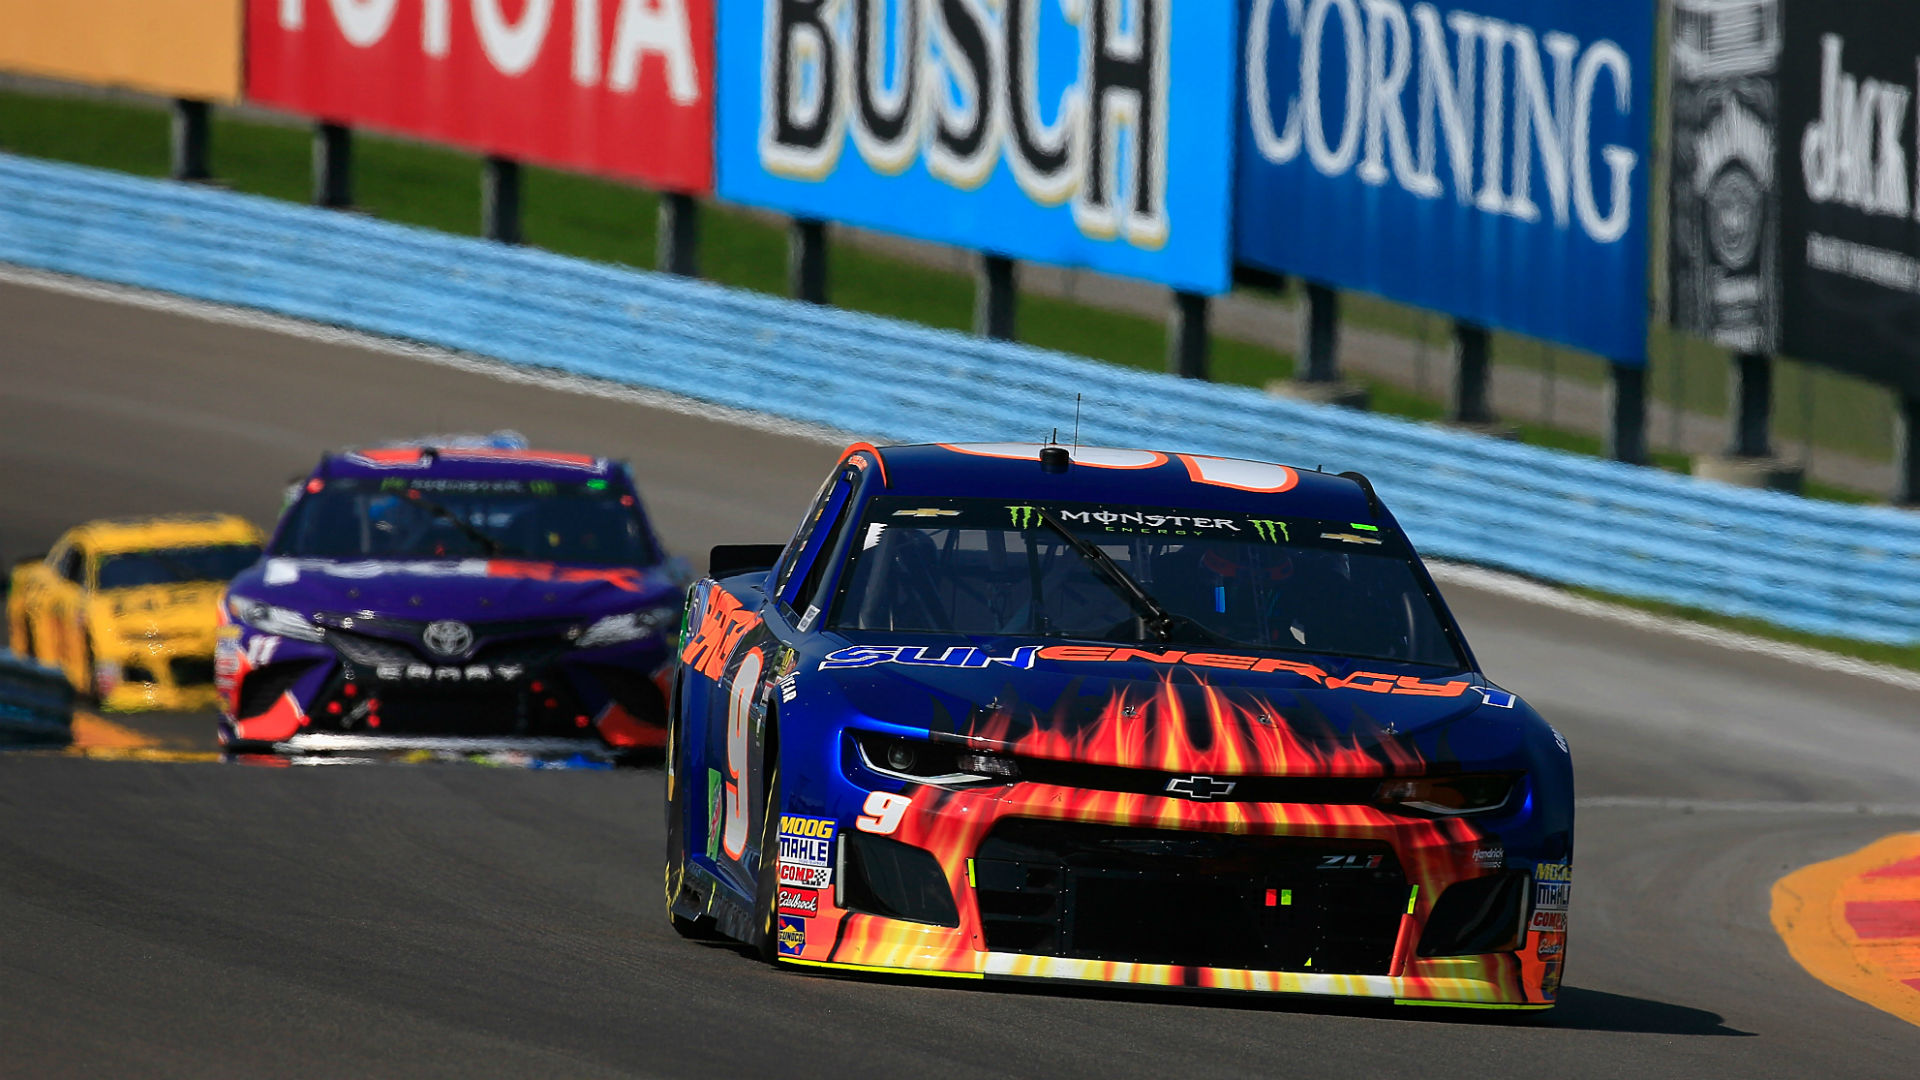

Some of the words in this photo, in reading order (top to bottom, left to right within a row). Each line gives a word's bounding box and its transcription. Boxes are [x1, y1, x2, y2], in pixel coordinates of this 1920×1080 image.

[760, 0, 1169, 248] BUSCH
[1246, 0, 1638, 243] CORNING
[1060, 510, 1241, 531] MONSTER
[1105, 526, 1203, 536] ENERGY
[723, 646, 764, 862] 9
[855, 790, 913, 836] 9
[780, 815, 836, 839] MOOG
[1472, 848, 1504, 862] Hendrick
[780, 864, 815, 882] COMP
[779, 890, 817, 912] Edelbrock
[779, 930, 804, 943] SUNOCO
